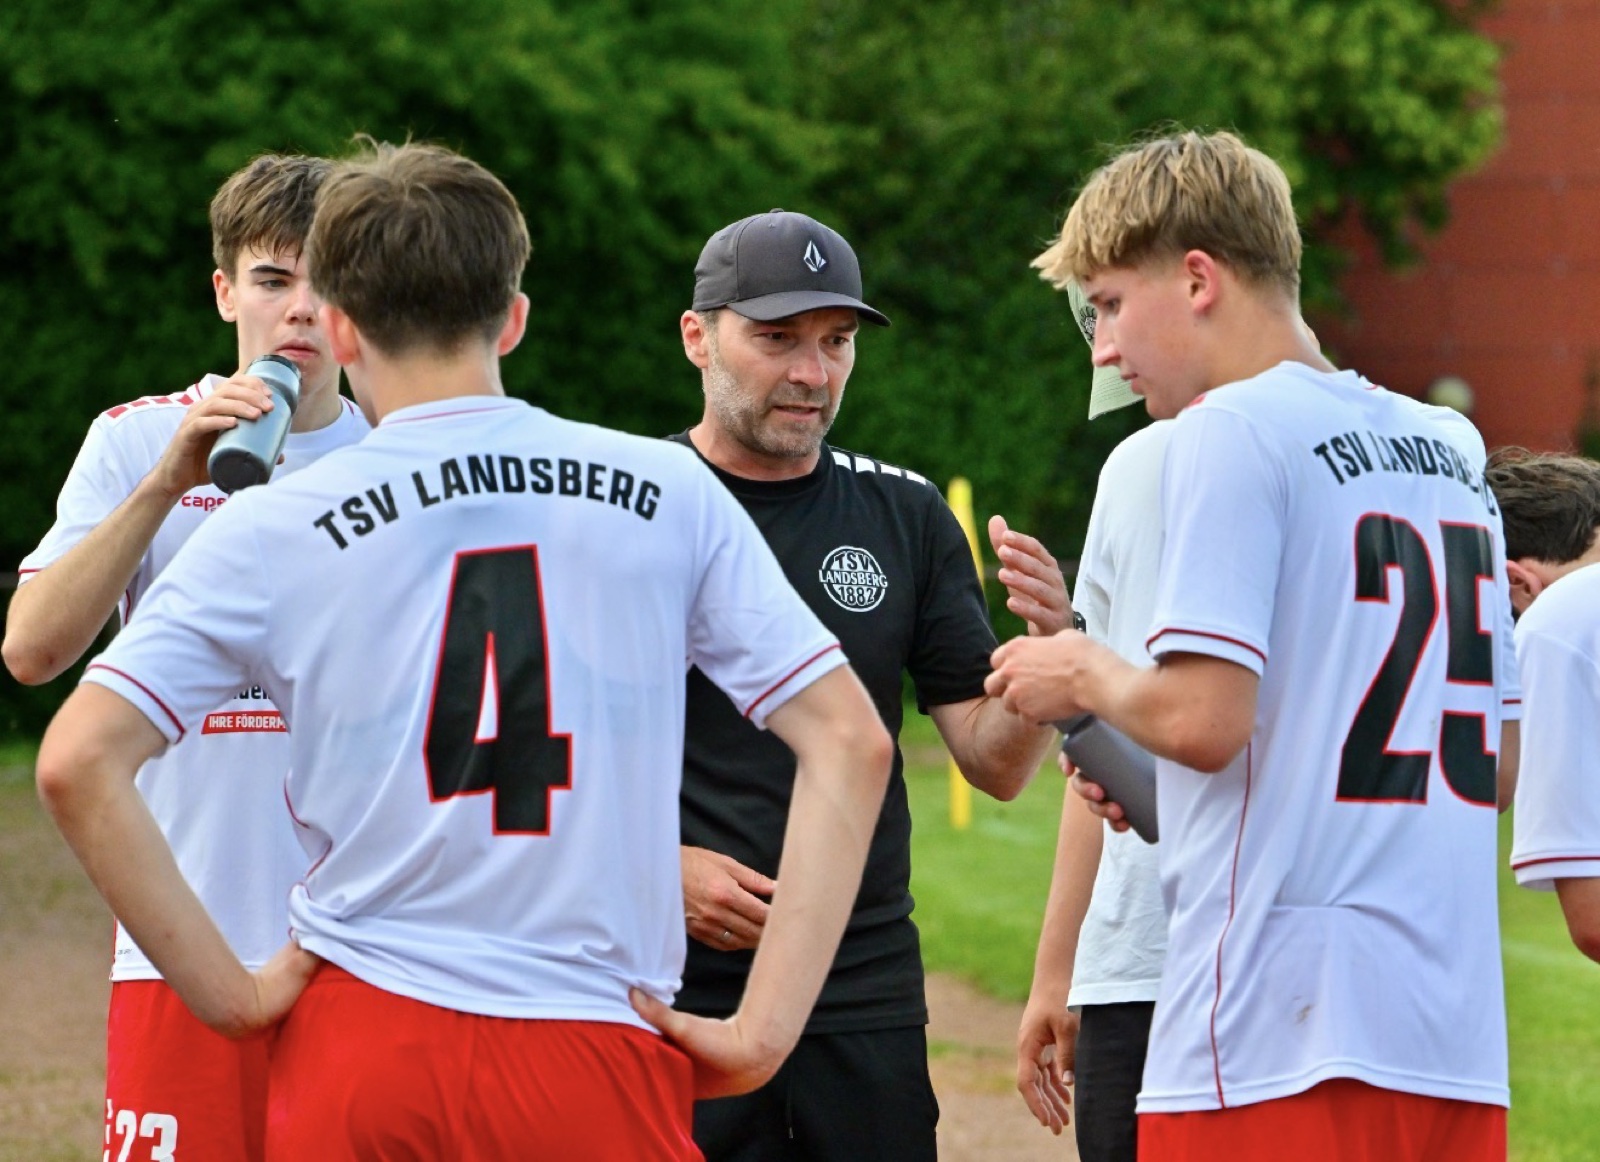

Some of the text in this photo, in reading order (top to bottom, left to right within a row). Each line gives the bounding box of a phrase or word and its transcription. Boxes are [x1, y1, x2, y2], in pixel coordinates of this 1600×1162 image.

[1313, 430, 1374, 486] TSV
[313, 454, 662, 550] TSV LANDSBERG
[818, 569, 888, 588] LANDSBERG
[834, 551, 870, 570] TSV
[838, 586, 875, 606] 1882
[1335, 511, 1498, 808] 25
[423, 544, 572, 836] 4
[208, 715, 234, 728] IHRE
[115, 1109, 178, 1162] 23
